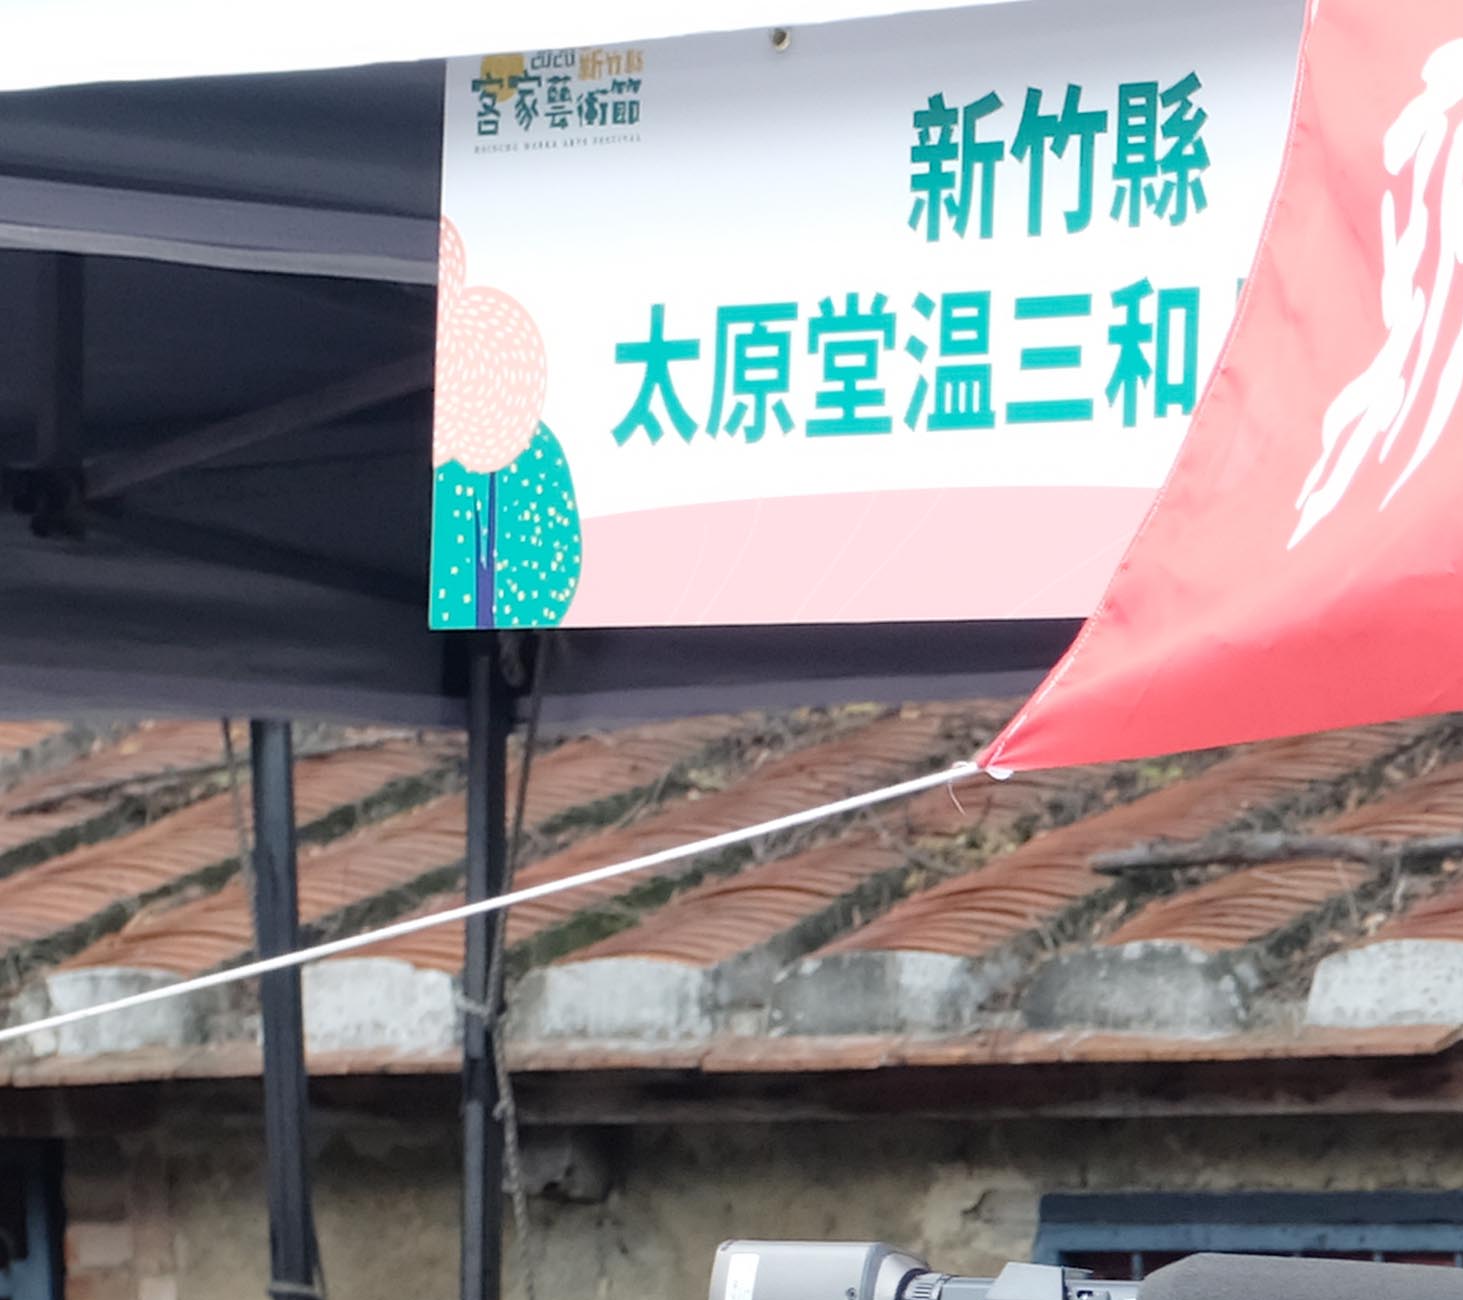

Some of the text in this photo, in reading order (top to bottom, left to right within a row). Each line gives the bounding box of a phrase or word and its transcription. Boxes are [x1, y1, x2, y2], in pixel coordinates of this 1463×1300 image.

[471, 69, 643, 136] 客家藝術節
[908, 72, 1212, 243] 新竹縣
[611, 277, 1247, 446] 太原堂温三和
